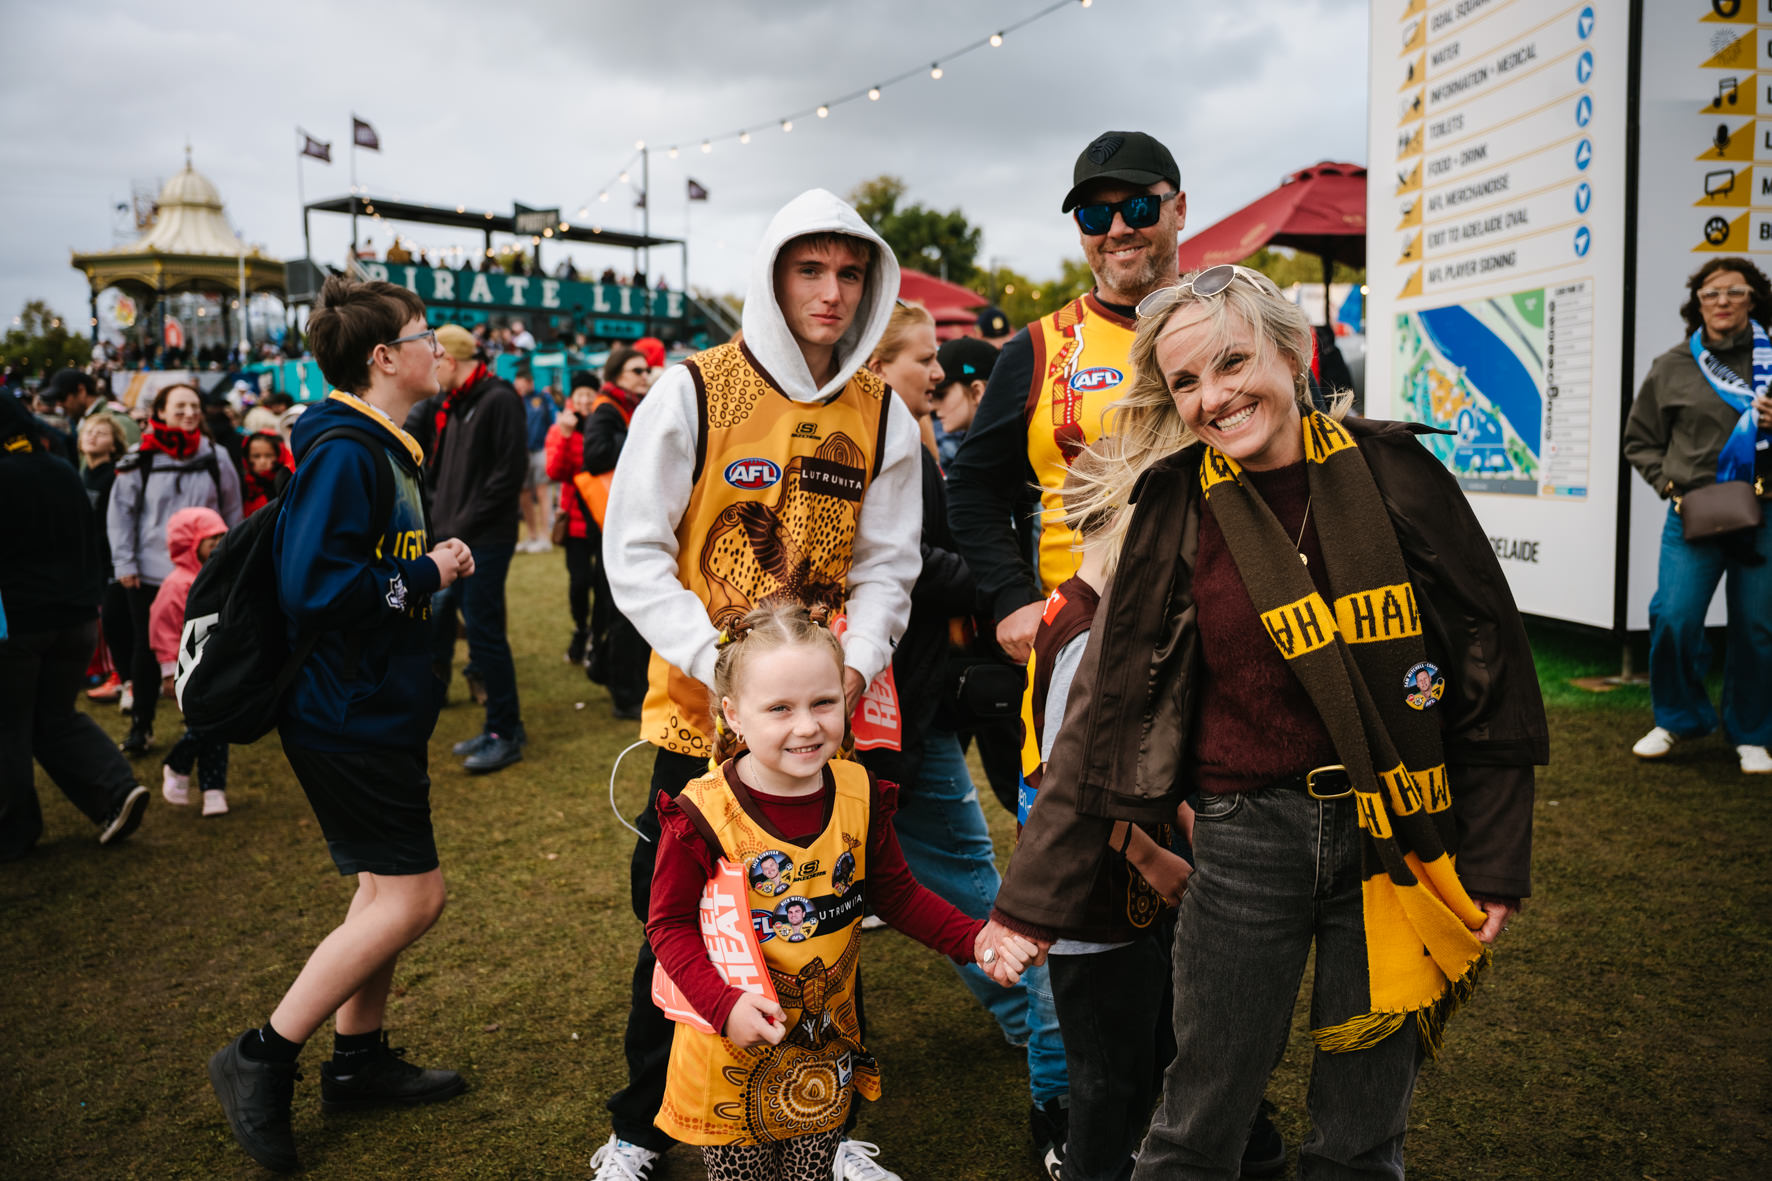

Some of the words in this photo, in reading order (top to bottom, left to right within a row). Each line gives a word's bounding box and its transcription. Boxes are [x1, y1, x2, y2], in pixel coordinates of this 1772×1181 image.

[1455, 0, 1491, 19] SQUA
[1431, 41, 1459, 67] WATER
[1430, 66, 1488, 104] INFORMATION
[1497, 42, 1537, 74] MEDICAL
[1430, 113, 1464, 139] TOILETS
[1448, 225, 1459, 243] TO
[1462, 213, 1502, 239] ADELAIDE
[1505, 207, 1528, 228] OVAL
[1445, 259, 1477, 280] PLAYER
[1480, 249, 1516, 273] SIGNING
[367, 262, 561, 309] PIRATE
[1074, 372, 1120, 388] AFL
[729, 465, 777, 483] AFL
[713, 883, 765, 994] HEAT
